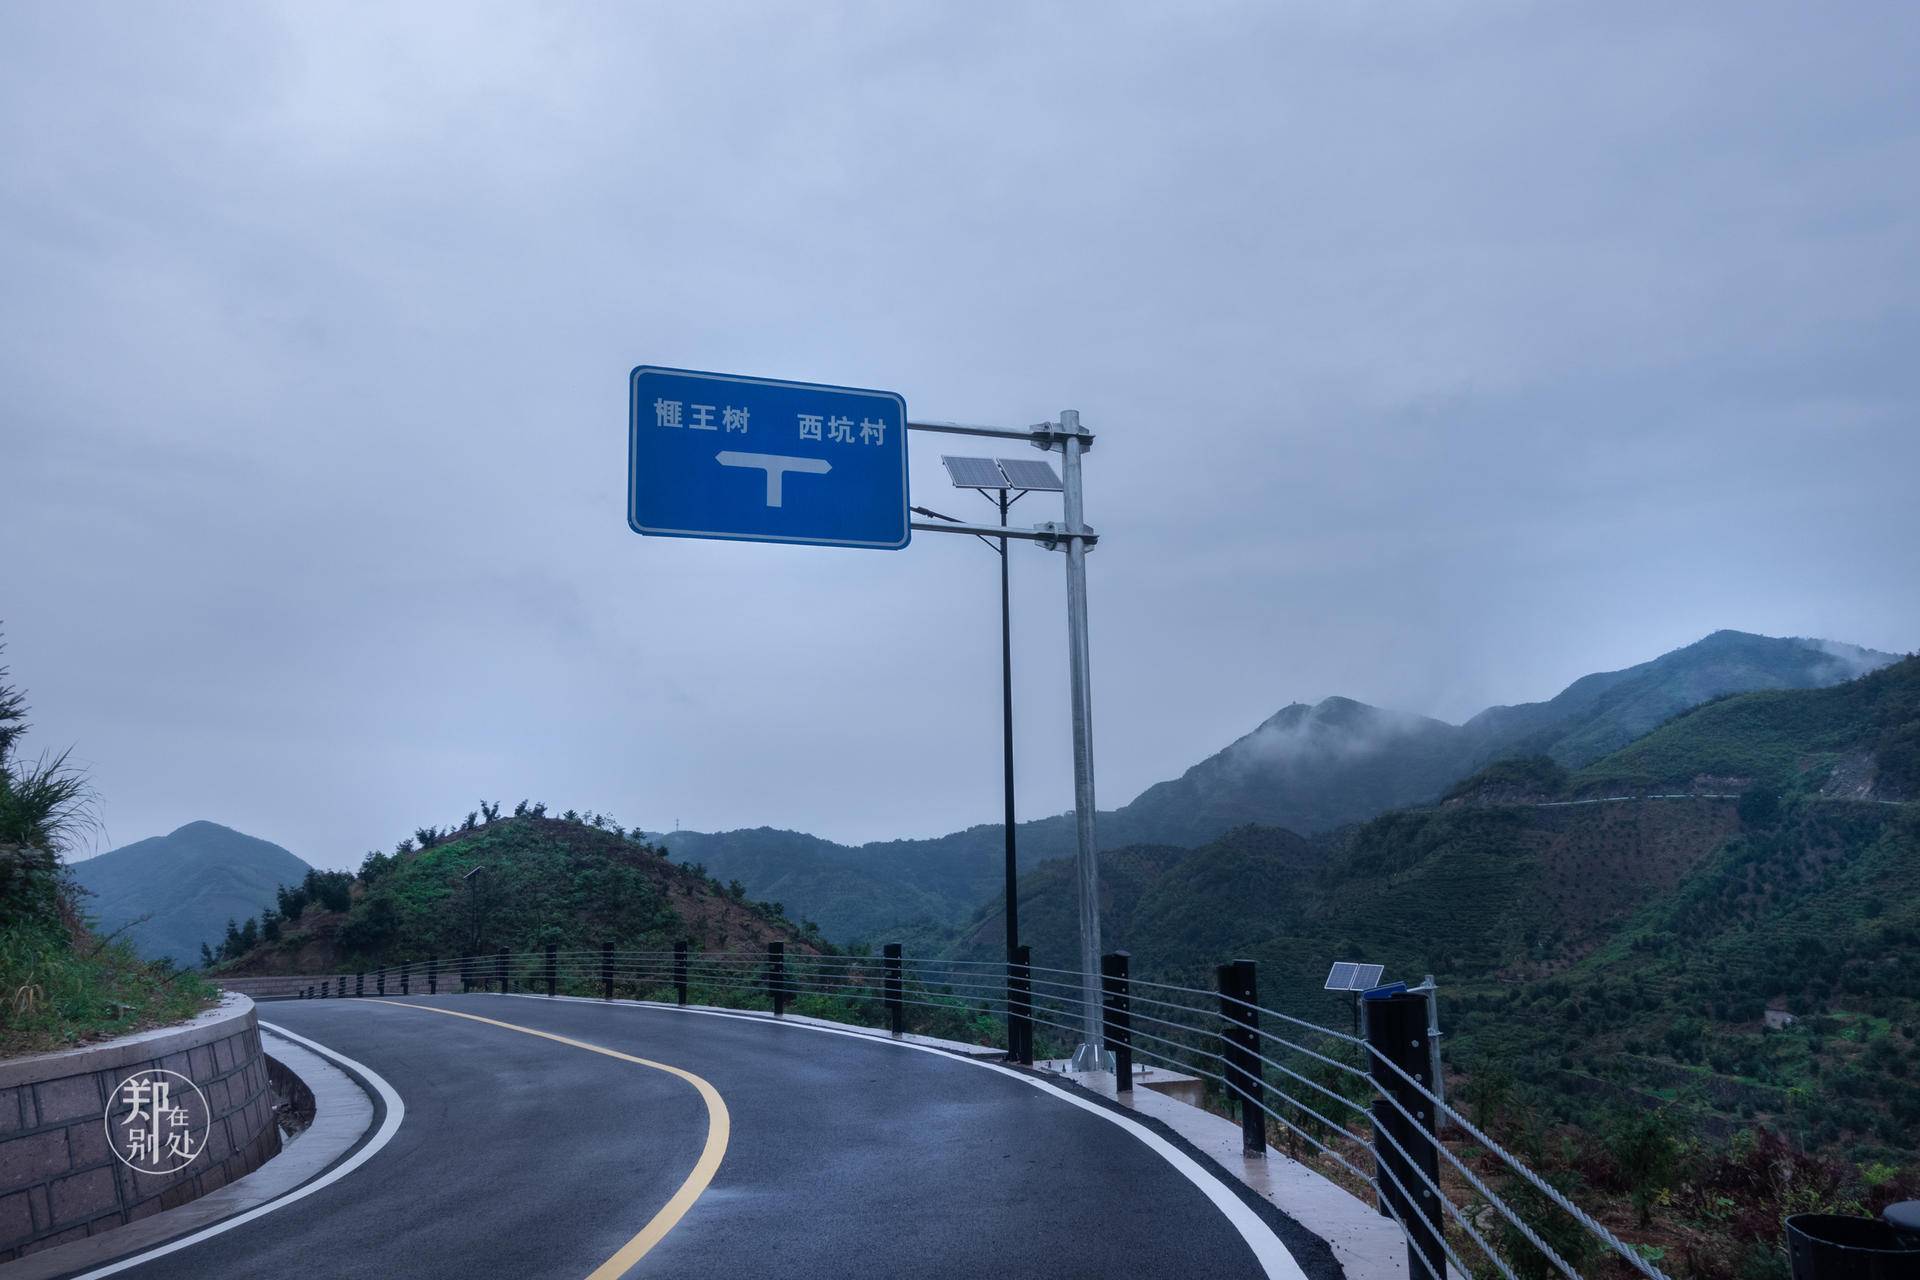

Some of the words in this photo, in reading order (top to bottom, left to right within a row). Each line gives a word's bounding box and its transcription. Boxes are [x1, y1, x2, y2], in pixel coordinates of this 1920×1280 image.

[653, 397, 750, 434] 榧王树
[797, 413, 887, 446] 西坑村
